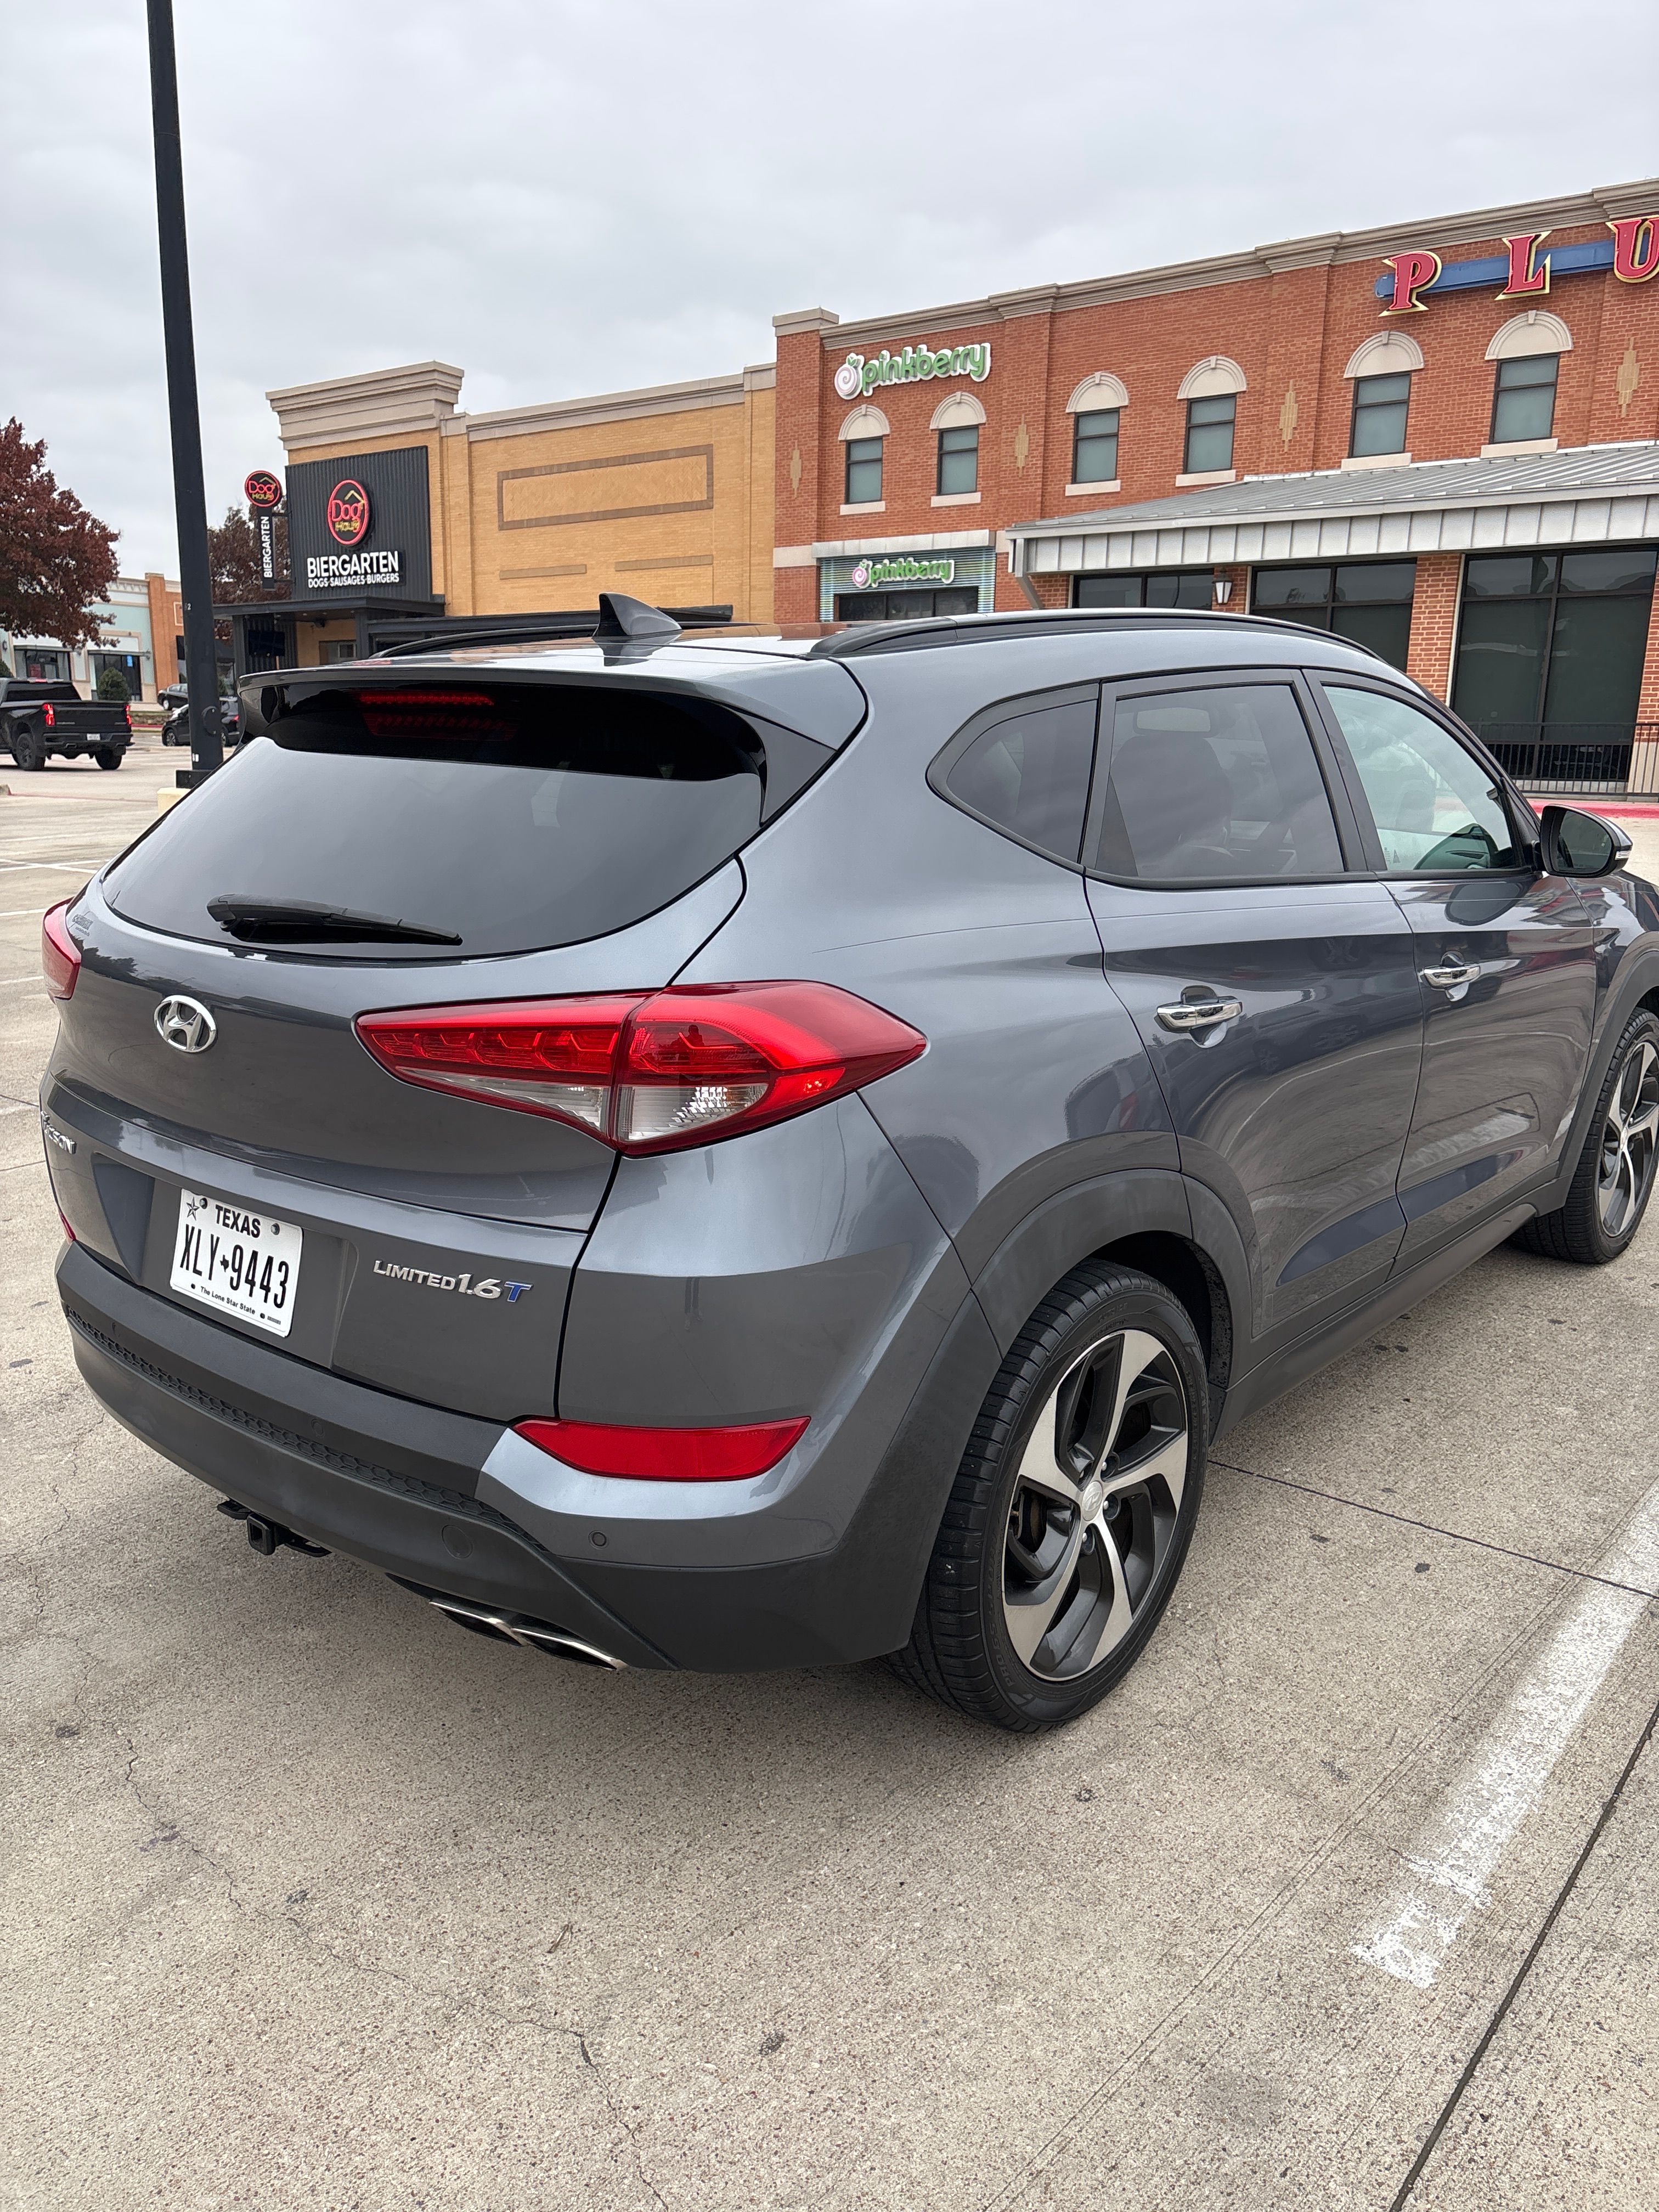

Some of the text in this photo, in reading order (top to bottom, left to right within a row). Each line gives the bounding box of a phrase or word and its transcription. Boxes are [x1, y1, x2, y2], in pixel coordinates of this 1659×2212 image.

[862, 344, 988, 394] pinkberry
[332, 500, 361, 532] Dog
[260, 516, 273, 578] BIERGARTEN
[307, 551, 399, 578] BIERGARTEN
[871, 558, 954, 587] pinkberry
[216, 1204, 261, 1238] TEXAS
[373, 1260, 456, 1290] LIMITED
[201, 1286, 255, 1314] The Lone Star State
